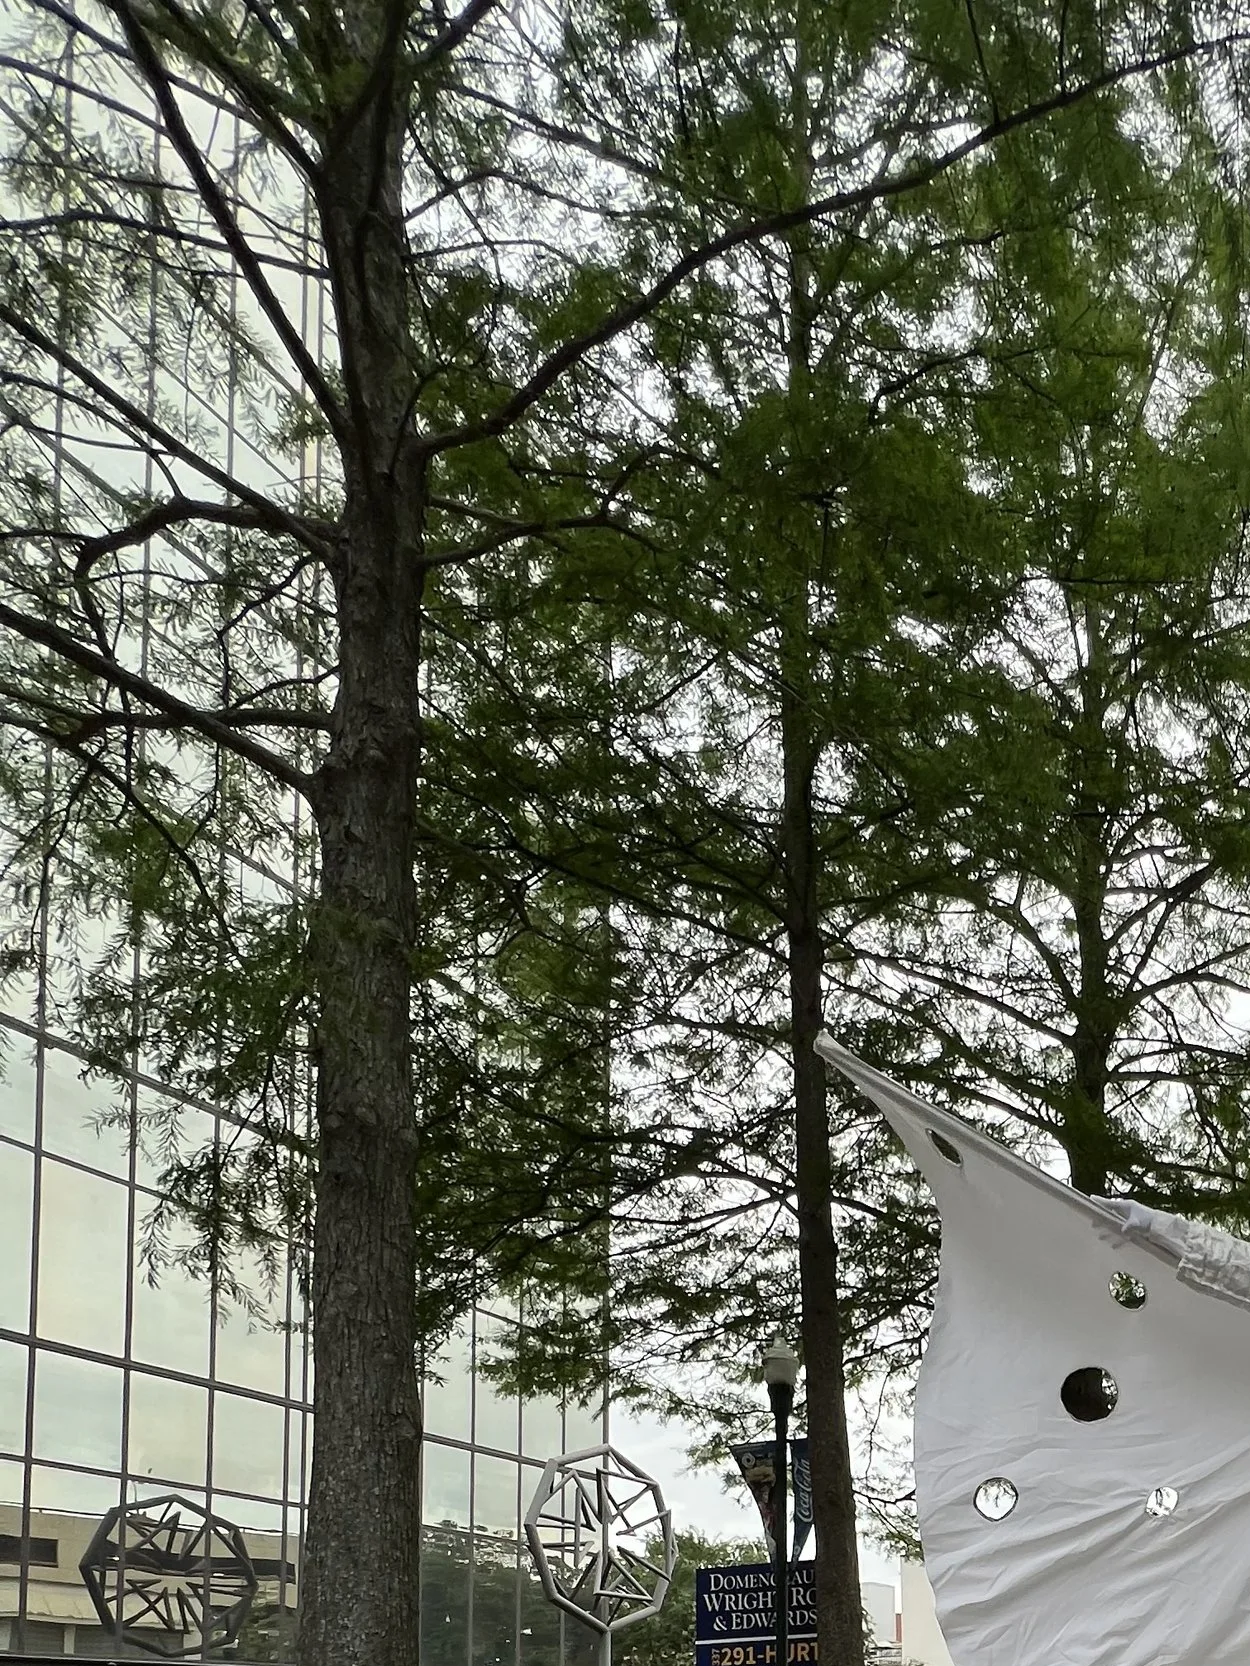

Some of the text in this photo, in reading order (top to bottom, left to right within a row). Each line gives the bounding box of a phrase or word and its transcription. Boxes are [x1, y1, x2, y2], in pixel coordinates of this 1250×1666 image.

[709, 1569, 814, 1591] DOMENAU
[703, 1587, 817, 1612] WRIGH RO
[713, 1615, 727, 1631] &
